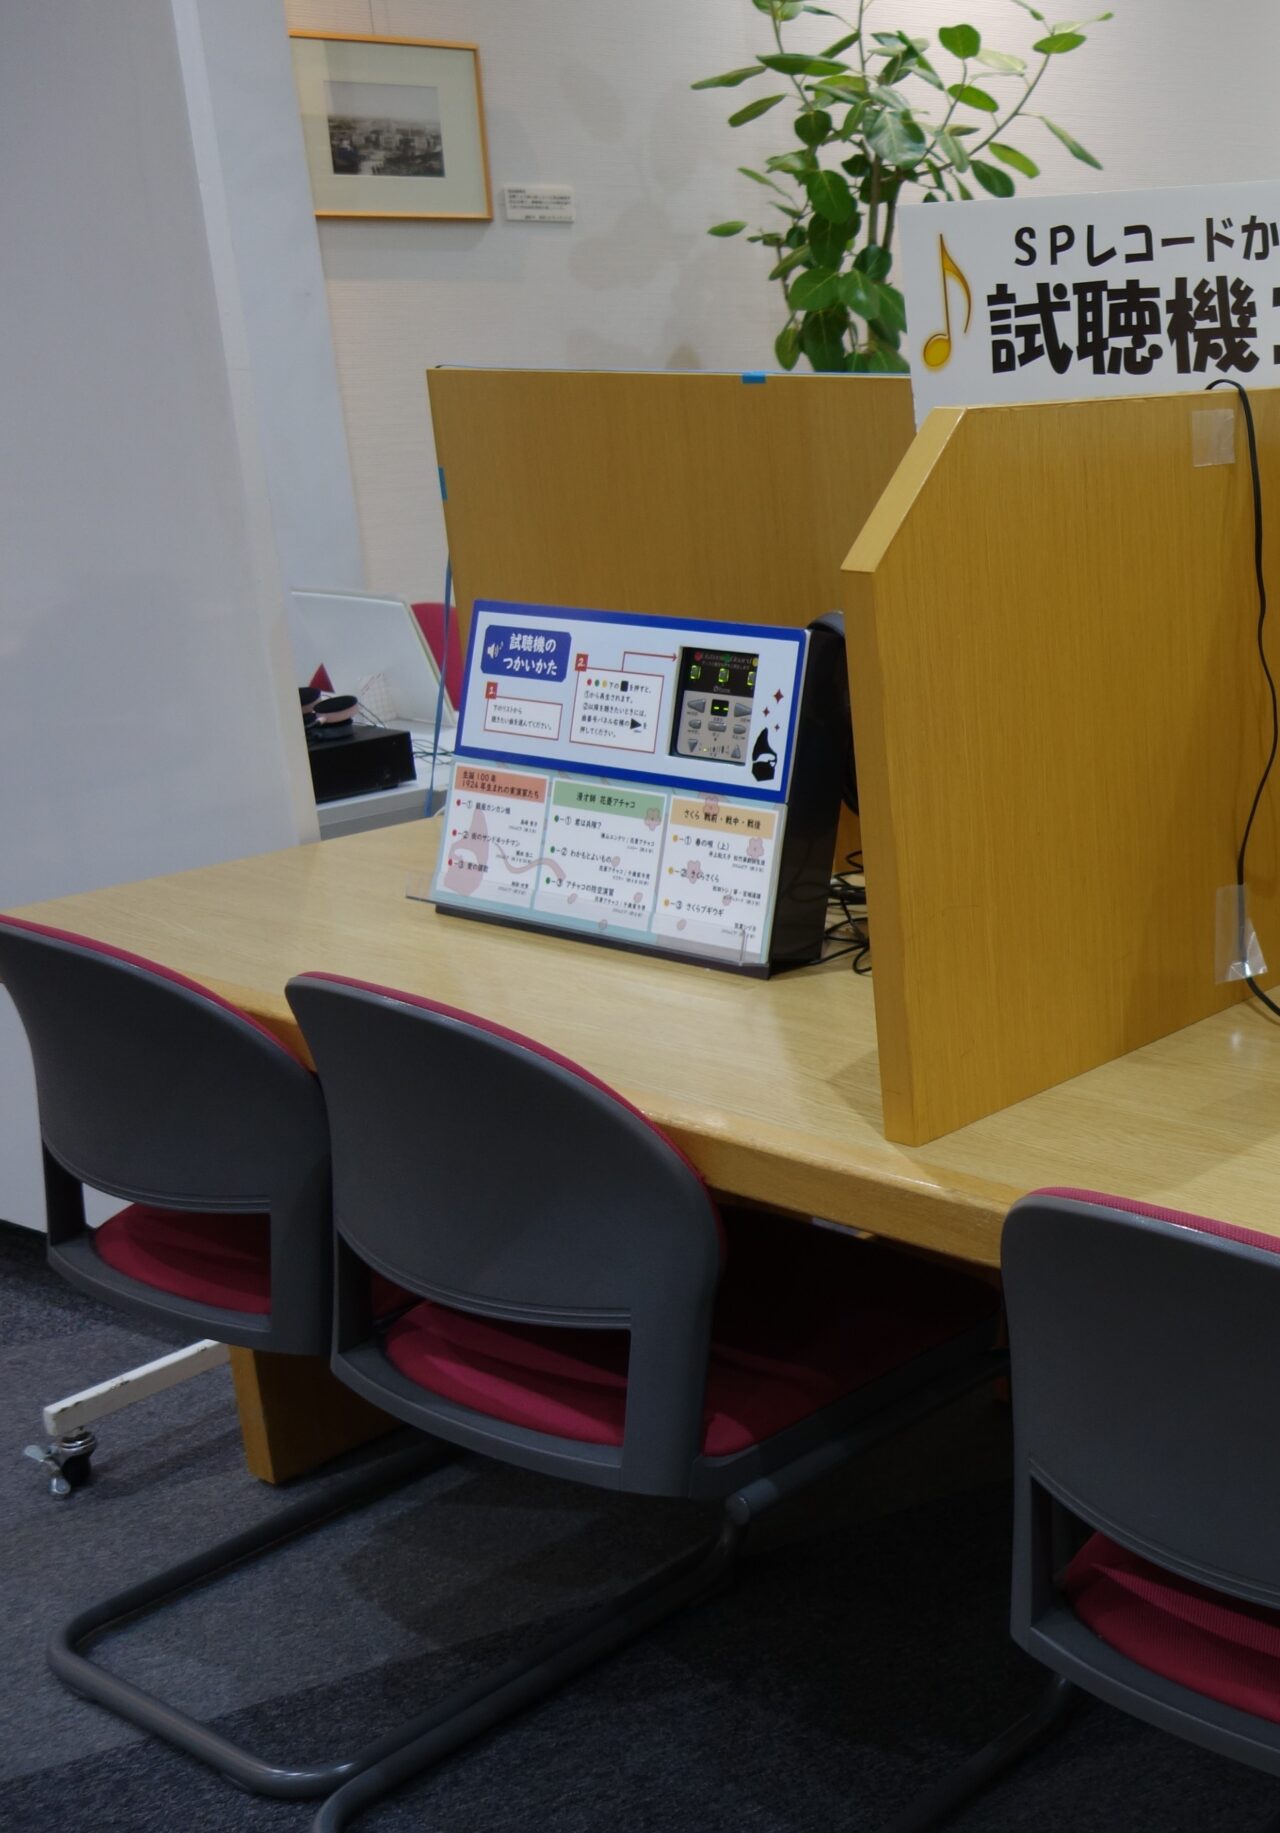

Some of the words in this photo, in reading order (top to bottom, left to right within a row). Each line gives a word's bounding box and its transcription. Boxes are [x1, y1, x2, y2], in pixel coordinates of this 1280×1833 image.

[509, 633, 556, 653] 試聴機の
[503, 656, 557, 676] つかいかた
